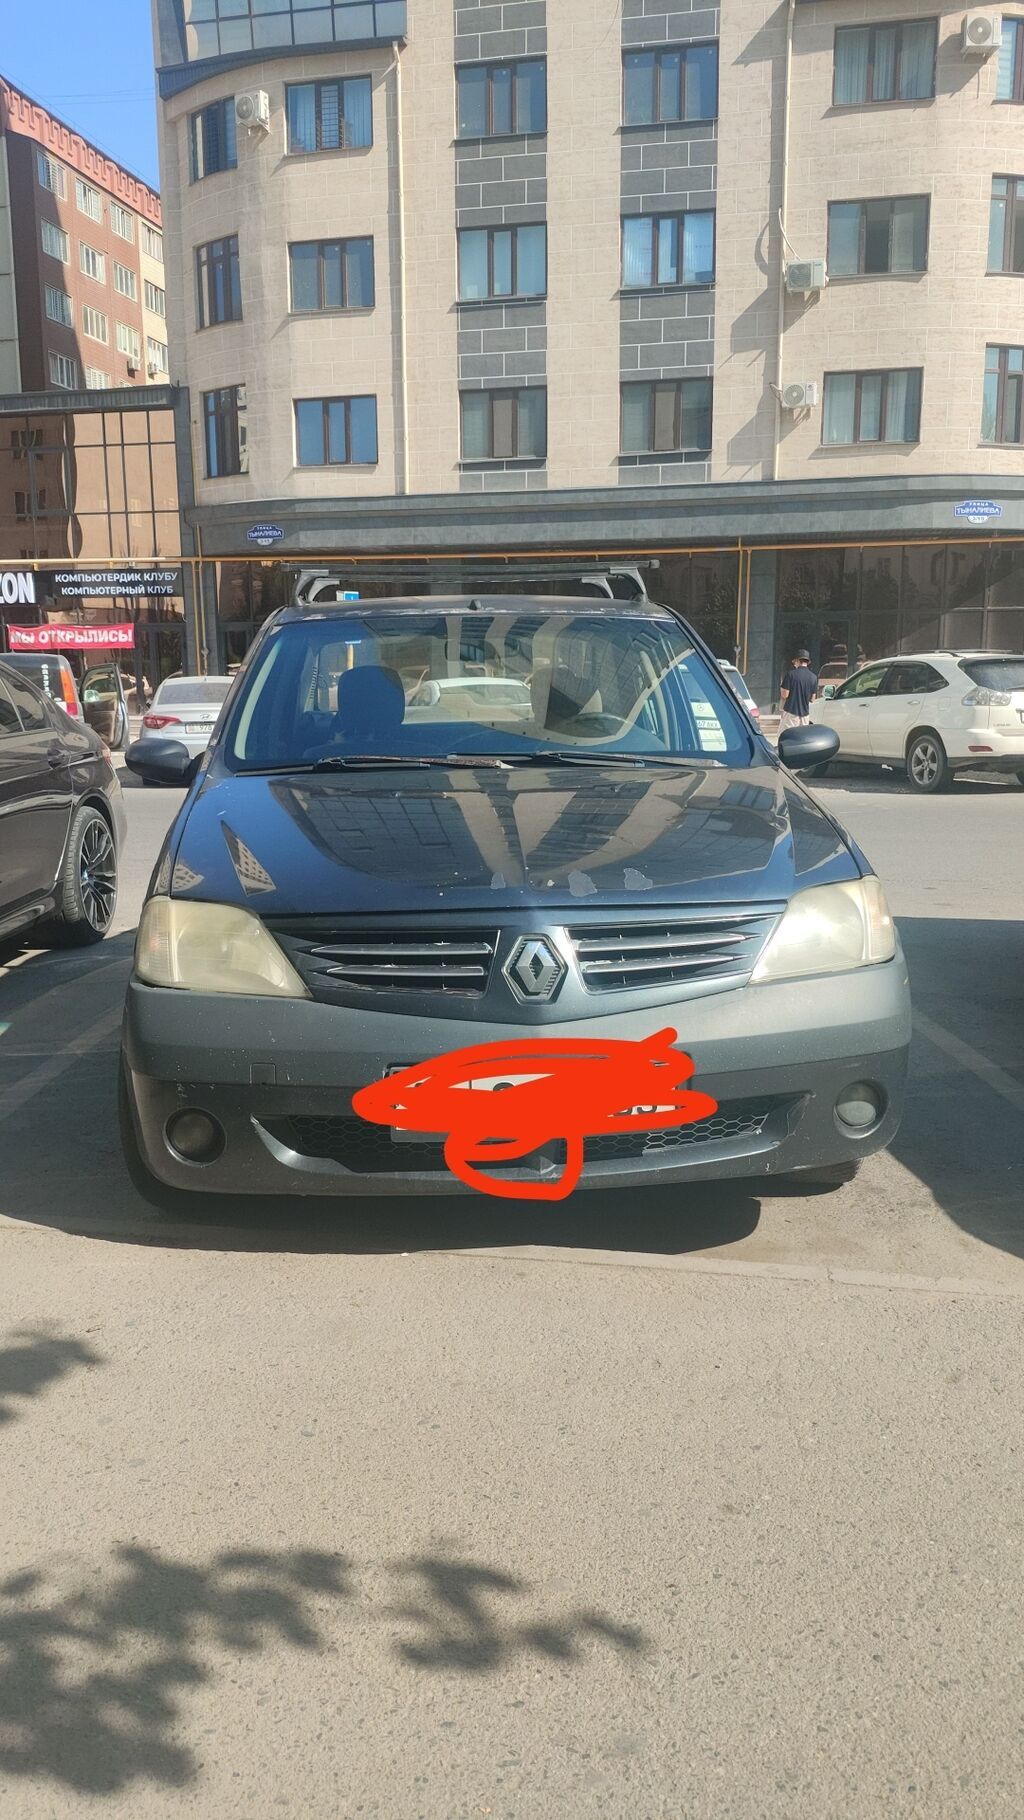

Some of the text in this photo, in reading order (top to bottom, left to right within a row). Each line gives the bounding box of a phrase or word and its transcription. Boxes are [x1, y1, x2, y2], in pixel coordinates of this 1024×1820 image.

[55, 572, 178, 583] КОМПЬЮТЕРДИК КЛУБУ
[61, 584, 174, 595] КОМПЬЮТЕРНЫЙ КЛУБ
[10, 630, 35, 643] МЫ
